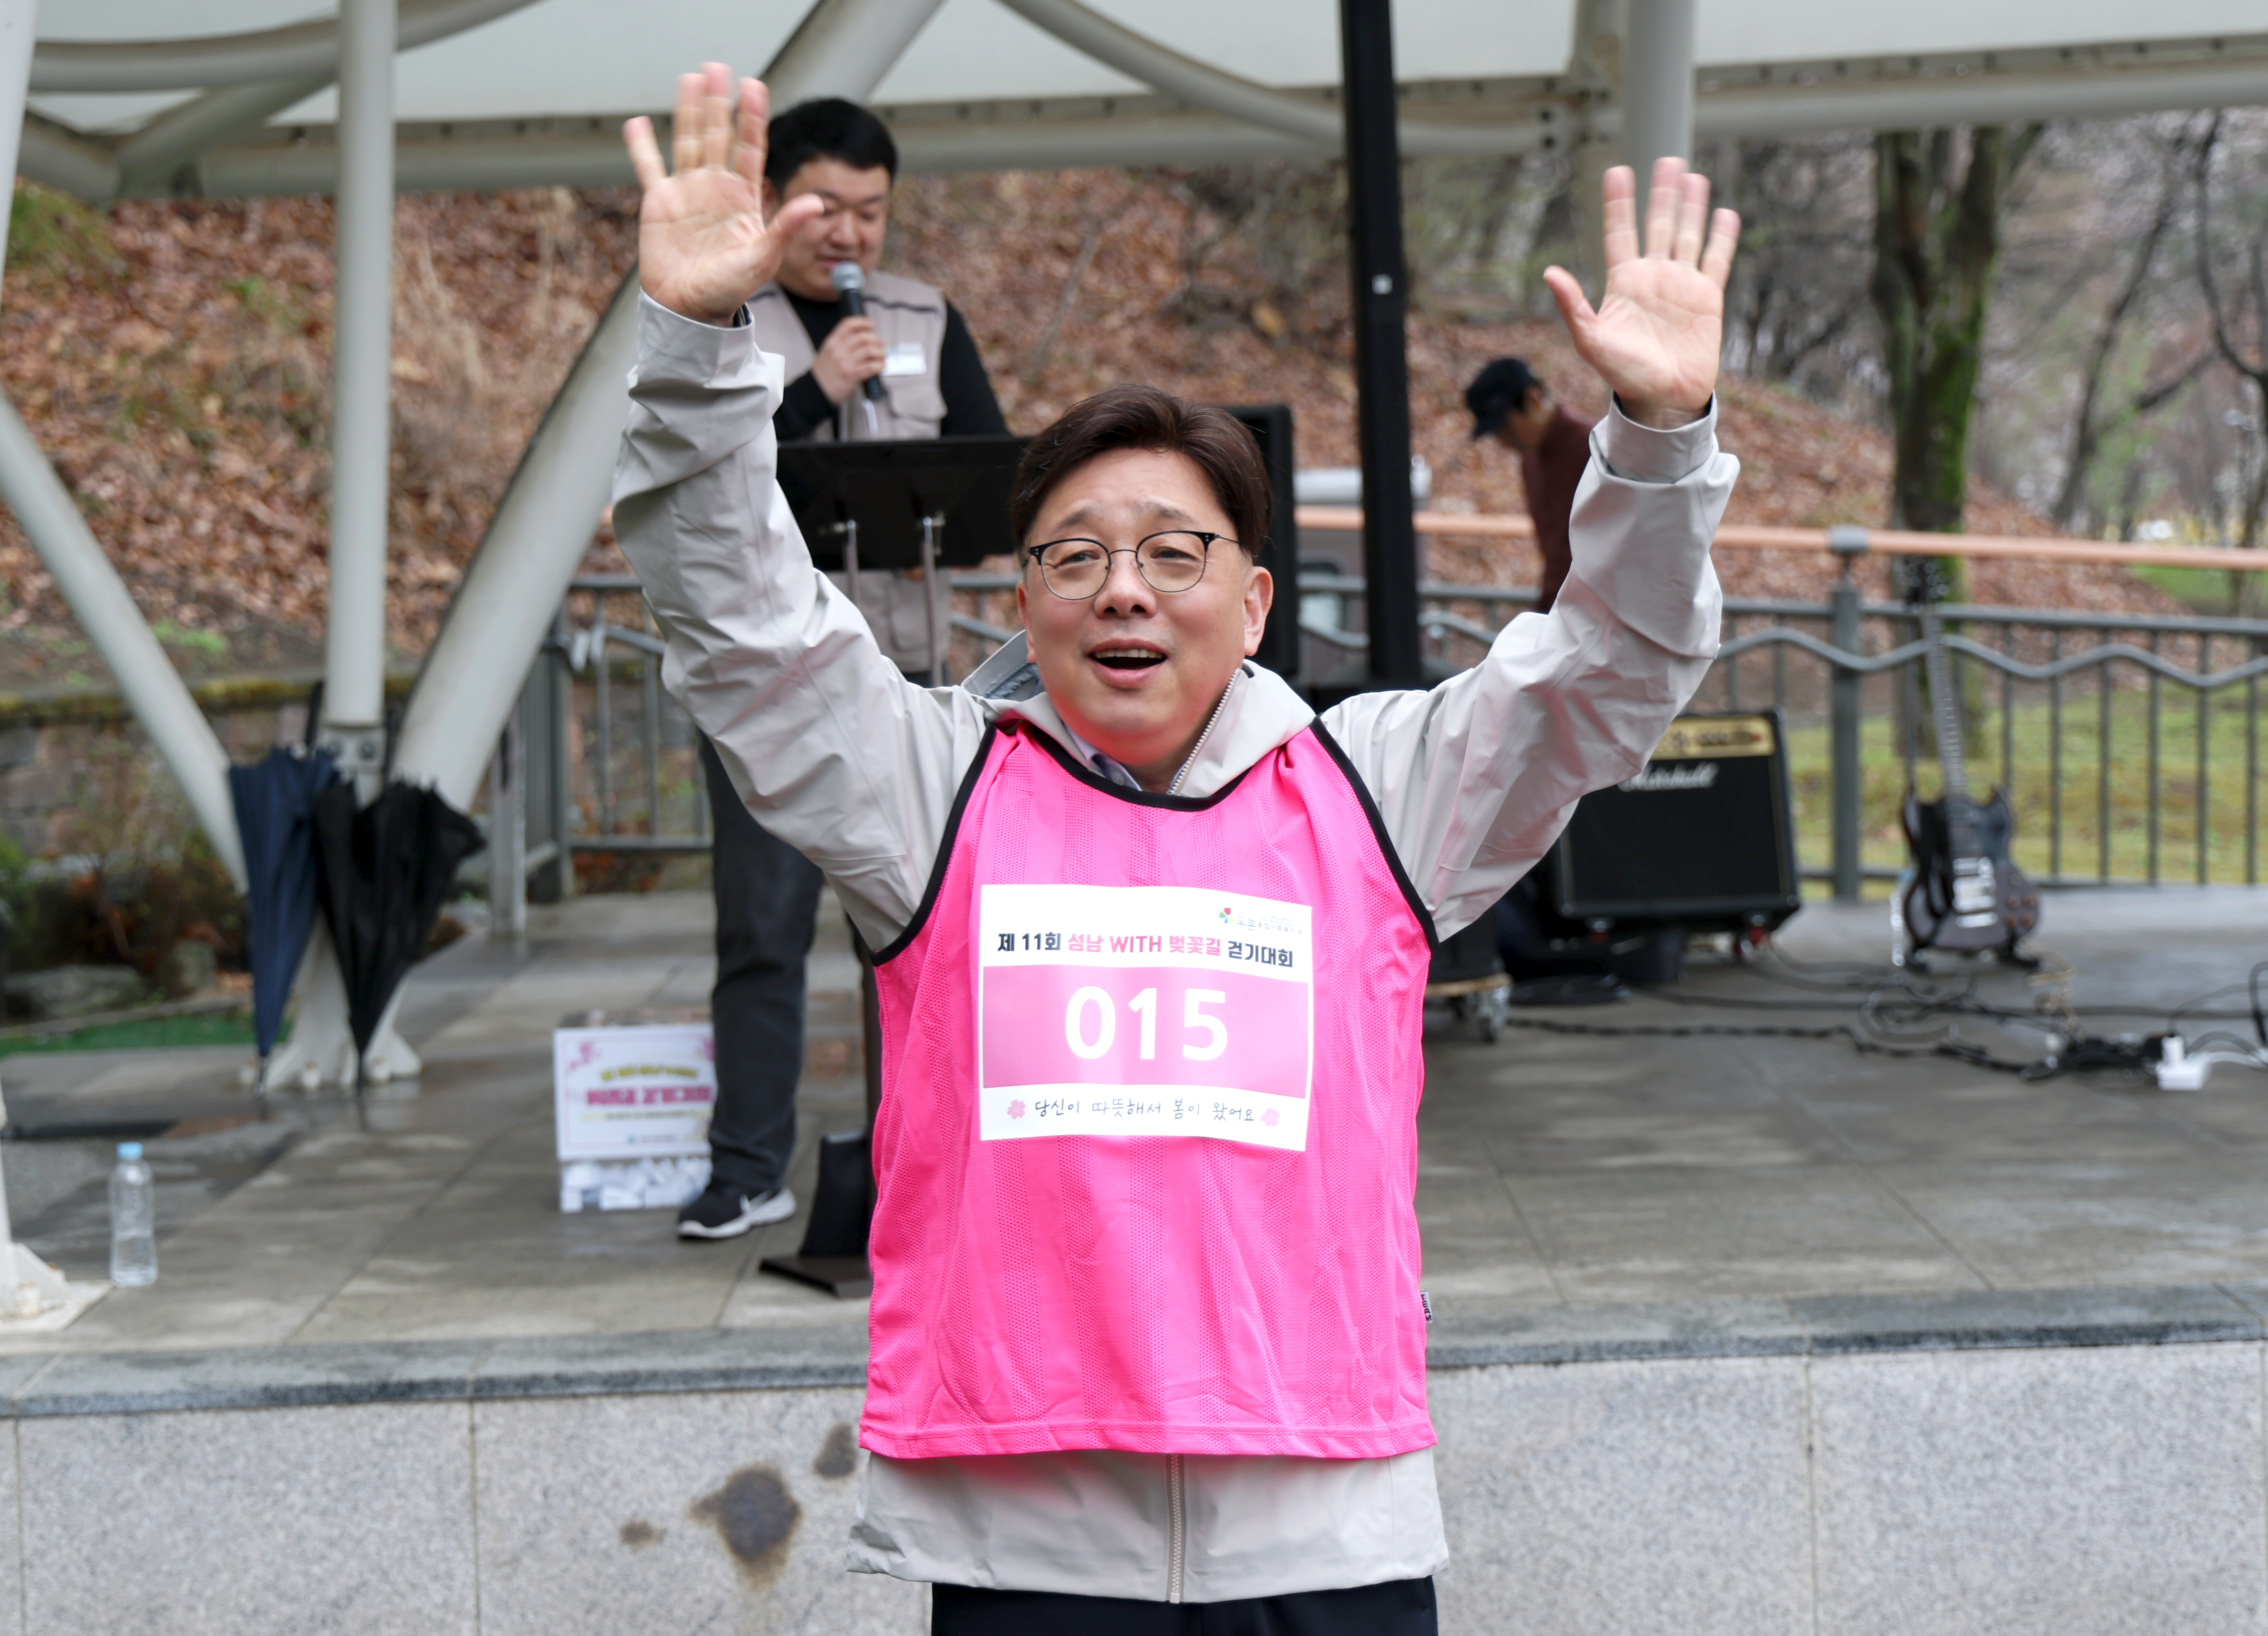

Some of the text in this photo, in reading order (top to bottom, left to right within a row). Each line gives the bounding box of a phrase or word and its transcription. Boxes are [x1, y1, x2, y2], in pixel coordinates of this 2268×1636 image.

[998, 932, 1293, 968] 제 11회 성남 WITH 벚꽃길 걷기대회
[1066, 986, 1227, 1061] 015
[1035, 1098, 1255, 1121] 당신이 따뜻해서 봄이 왔어요
